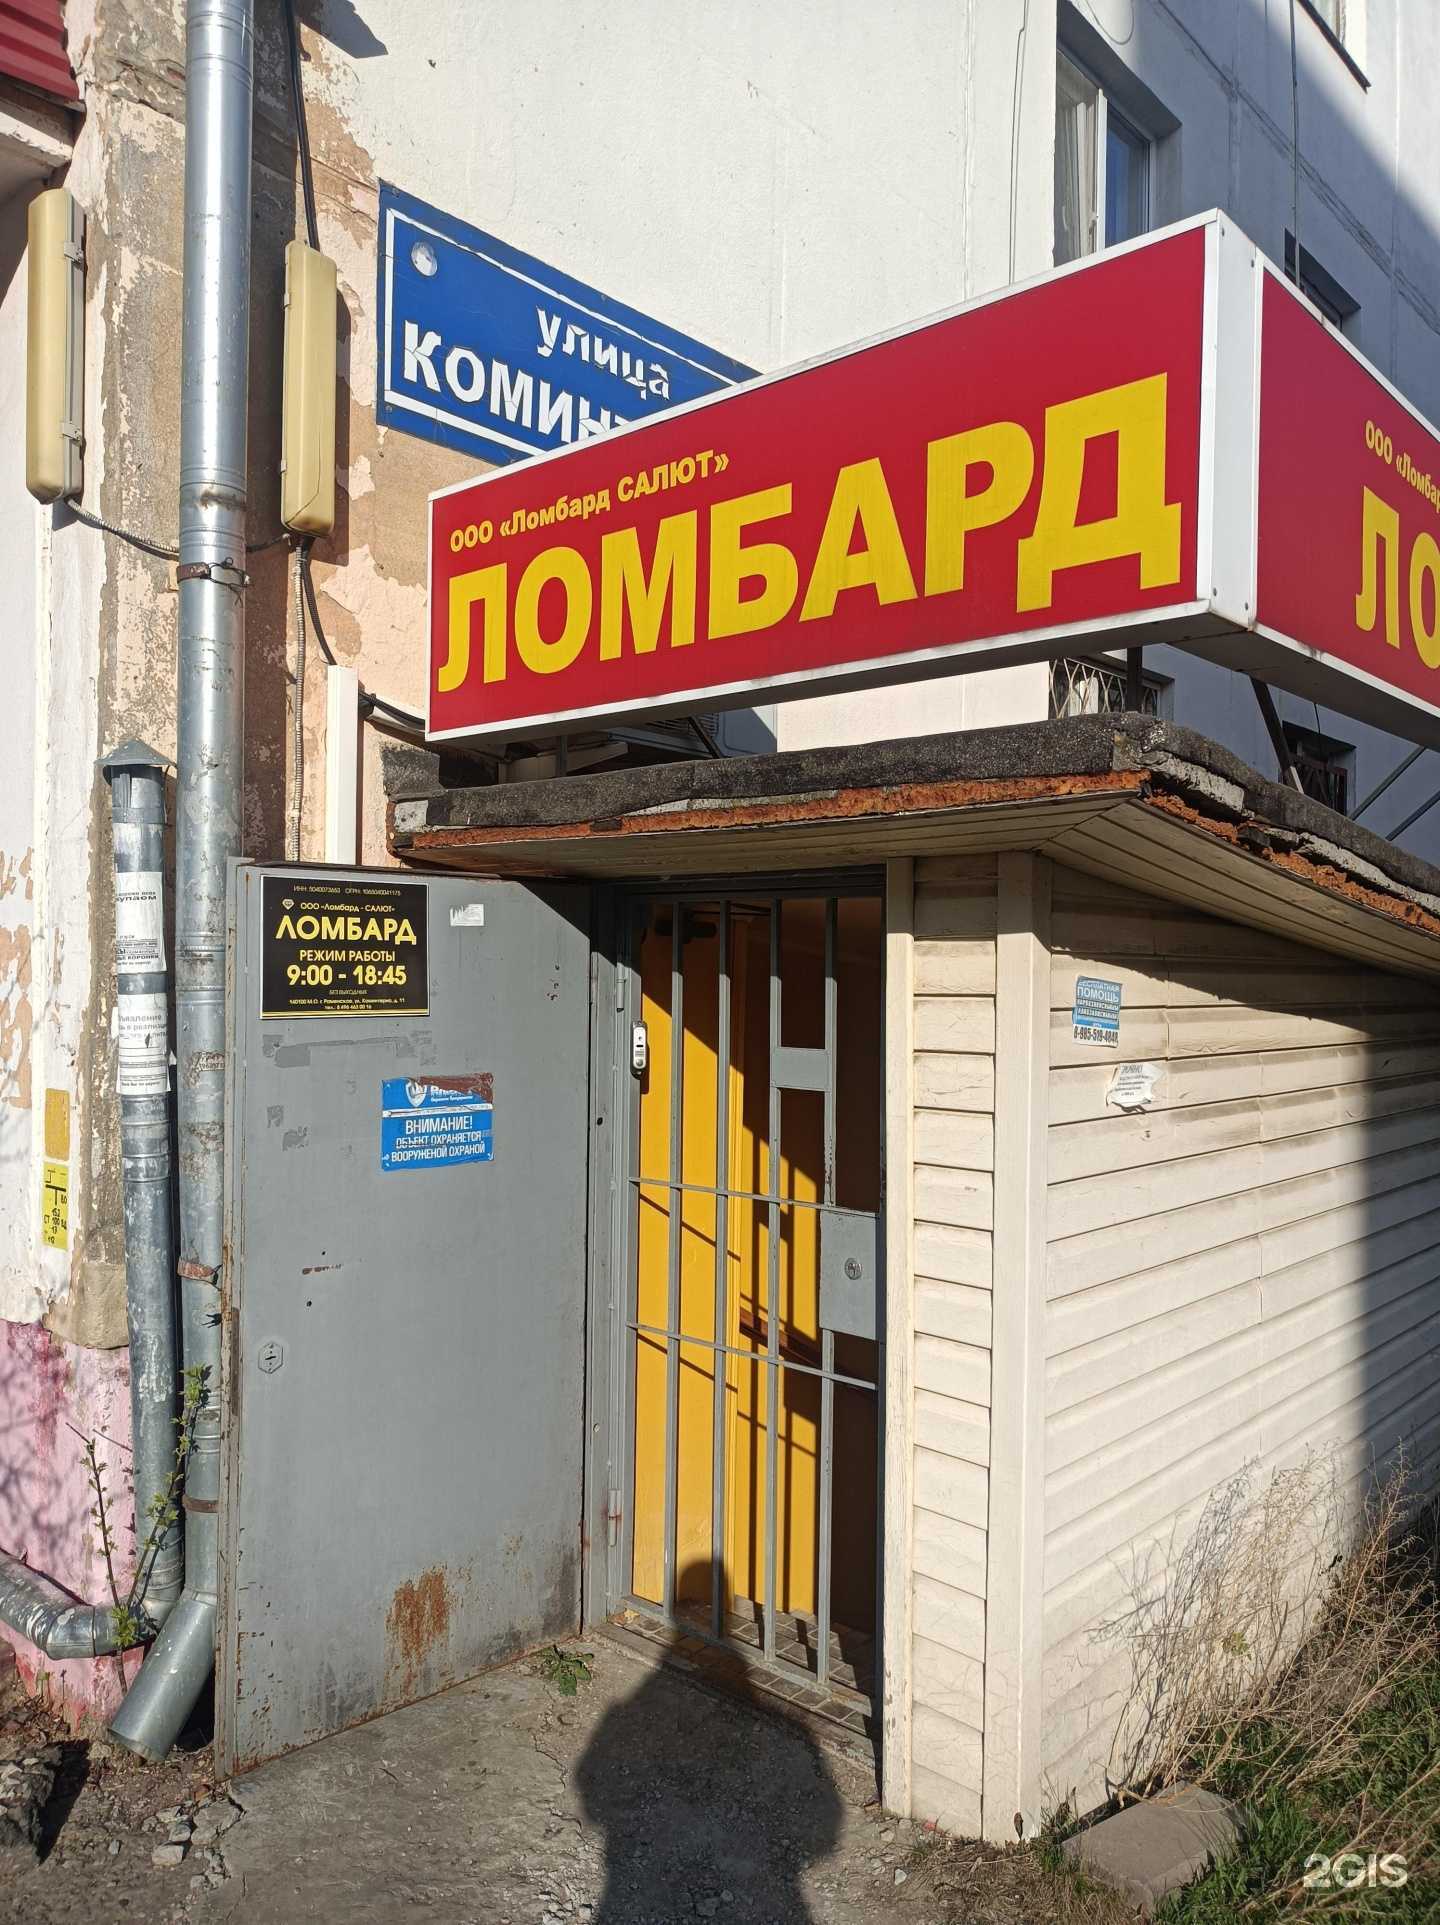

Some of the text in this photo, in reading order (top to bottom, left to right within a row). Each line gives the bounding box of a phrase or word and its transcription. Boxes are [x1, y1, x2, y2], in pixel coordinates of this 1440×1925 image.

[536, 305, 670, 400] улица
[403, 319, 630, 444] КОМИН
[1365, 419, 1393, 465] ООО
[450, 449, 730, 552] ООО «Ломбард САЛЮТ»
[438, 373, 1182, 693] ЛОМБАРД
[1355, 485, 1440, 669] ЛО
[300, 902, 320, 910] ООО
[275, 915, 417, 945] ЛОМБАРД
[299, 950, 396, 962] РЕЖИМ РАБОТЫ
[287, 965, 333, 986] 9:00
[353, 965, 407, 985] 18:45
[1077, 986, 1119, 1003] ПОМОЩЬ
[405, 1116, 473, 1134] ВНИМАНИЕ!
[396, 1130, 482, 1149] ОБЪЕКТ ОХРАНЯЕТСЯ
[449, 1141, 485, 1157] ОХРАНОЙ
